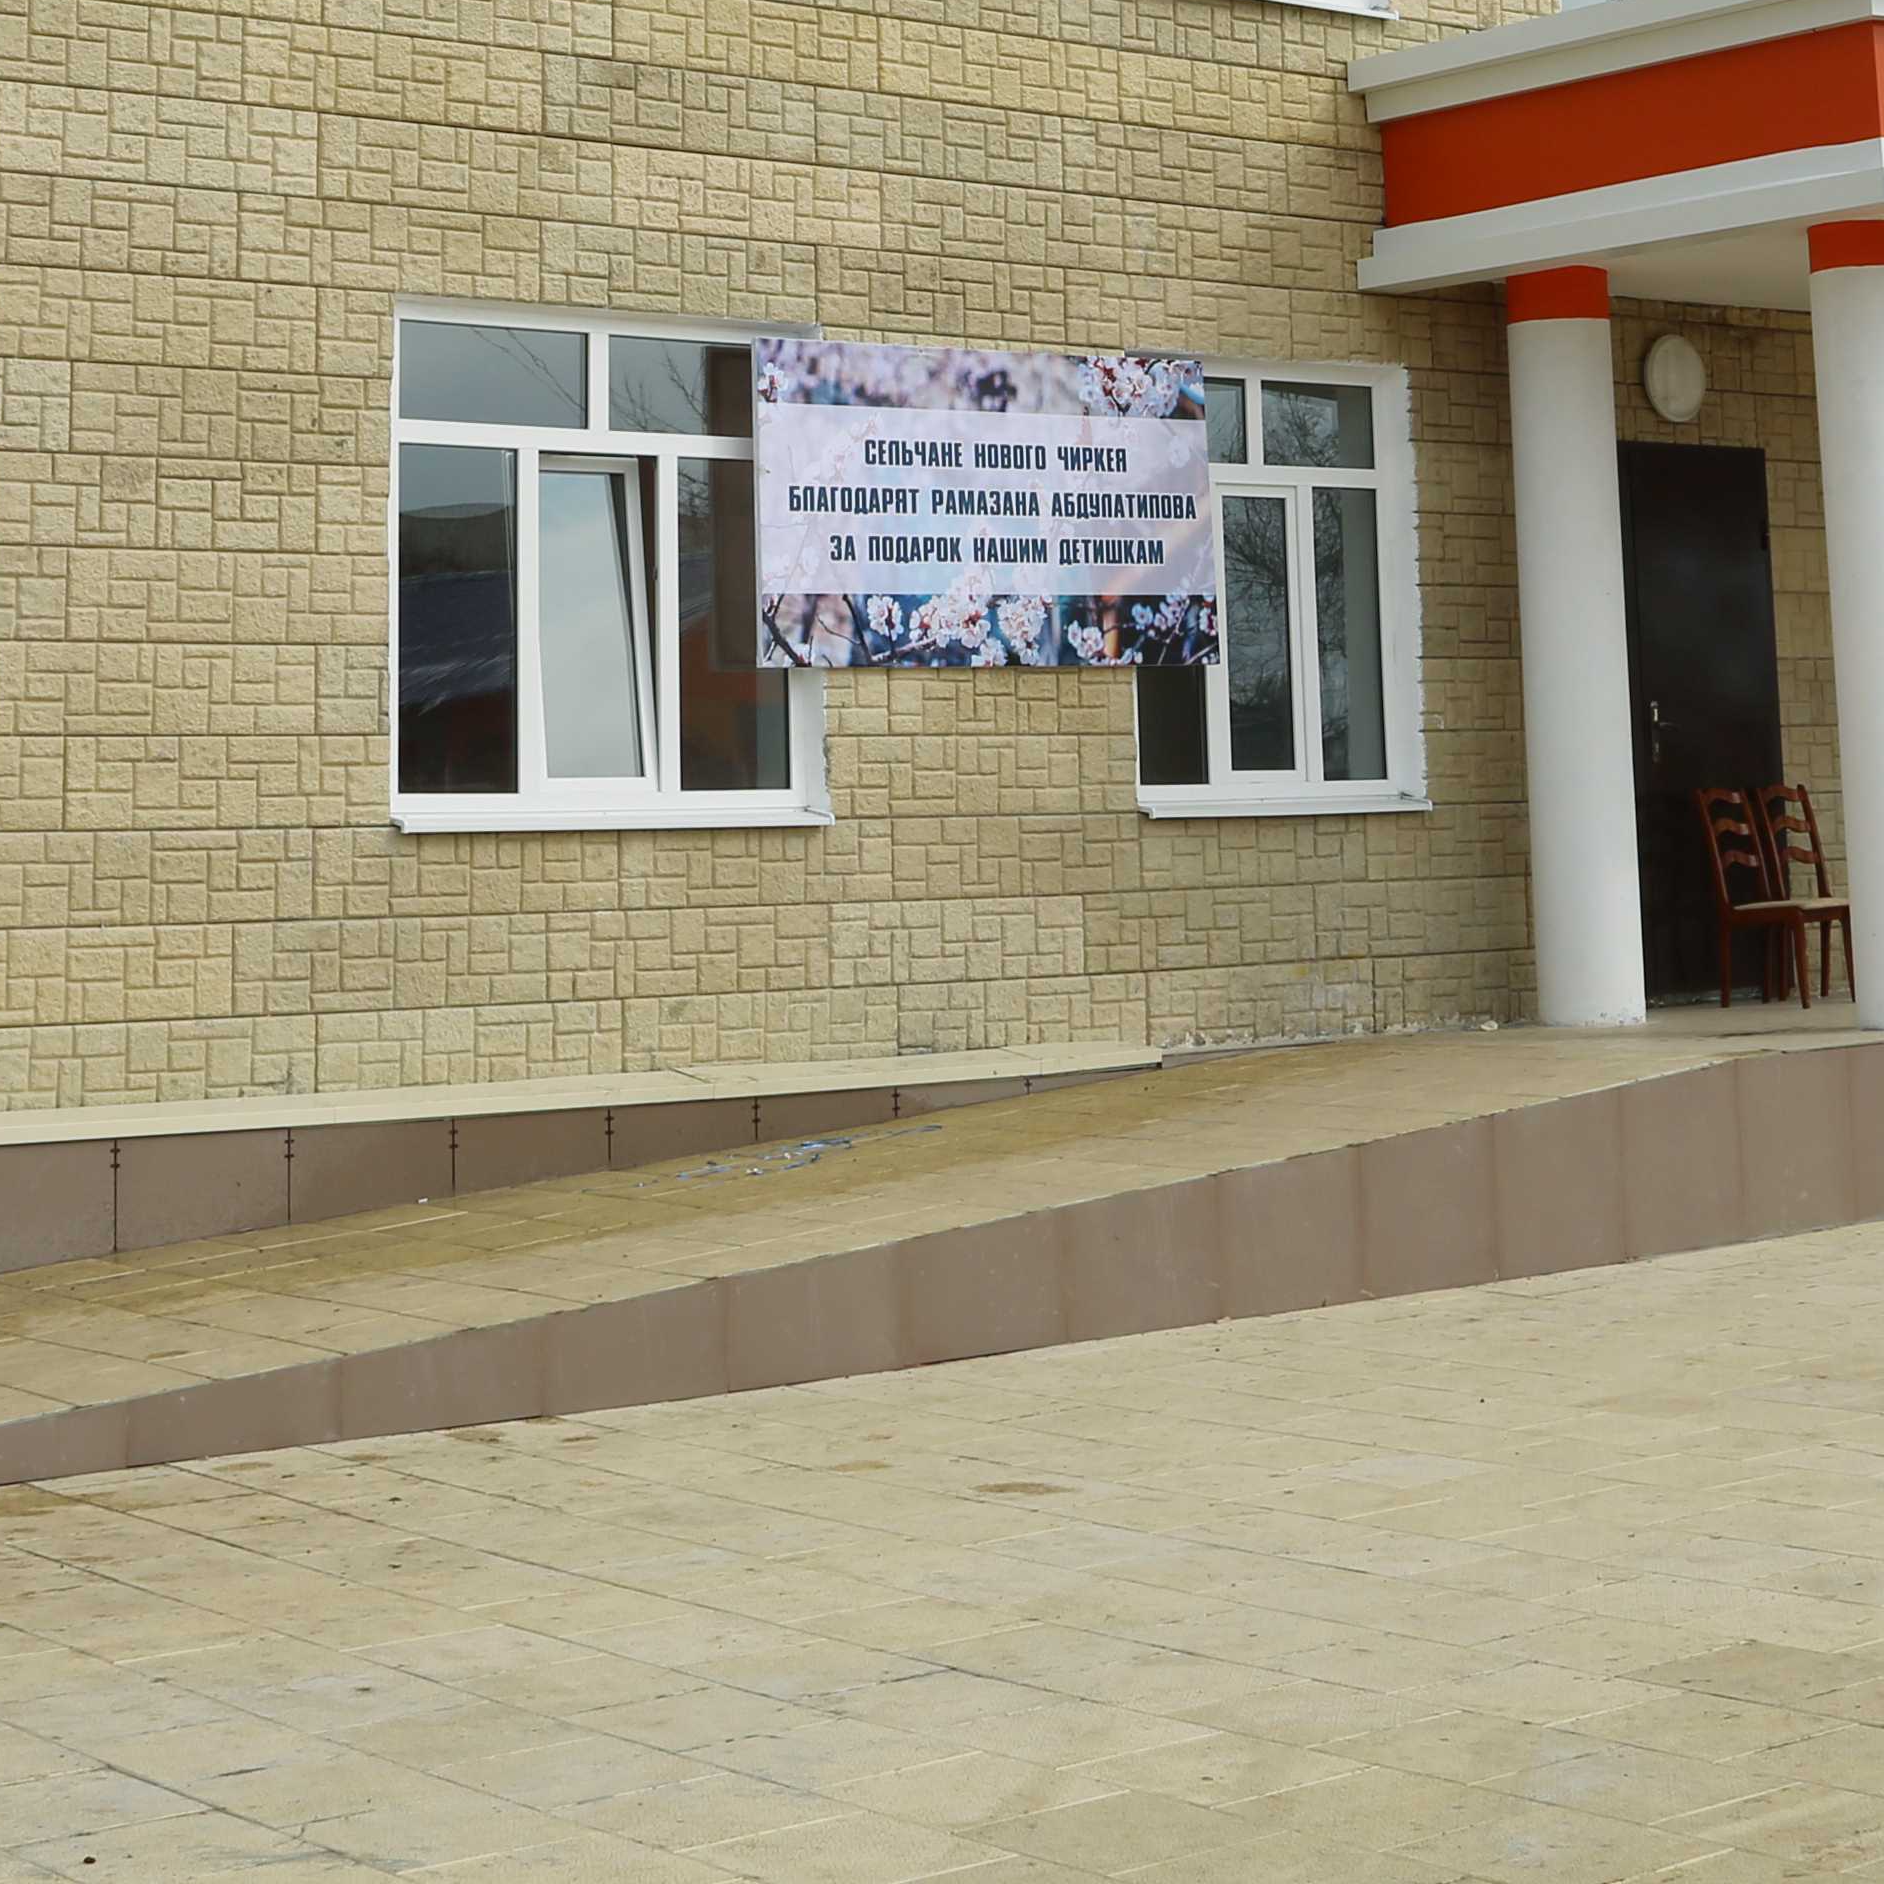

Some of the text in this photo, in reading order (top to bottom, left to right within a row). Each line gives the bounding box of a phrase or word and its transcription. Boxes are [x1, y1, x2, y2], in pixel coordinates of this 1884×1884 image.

[864, 439, 1127, 473] СЕЛЬЧАНЕ НОВОГО ЧИРКЕЯ
[788, 486, 1197, 520] БЛАГОДАРЯТ РАМАЗАНА АБДУЛАТИПОВА
[829, 536, 1164, 566] ЗА ПОДАРОК НАШИМ ДЕТИШКАМ
